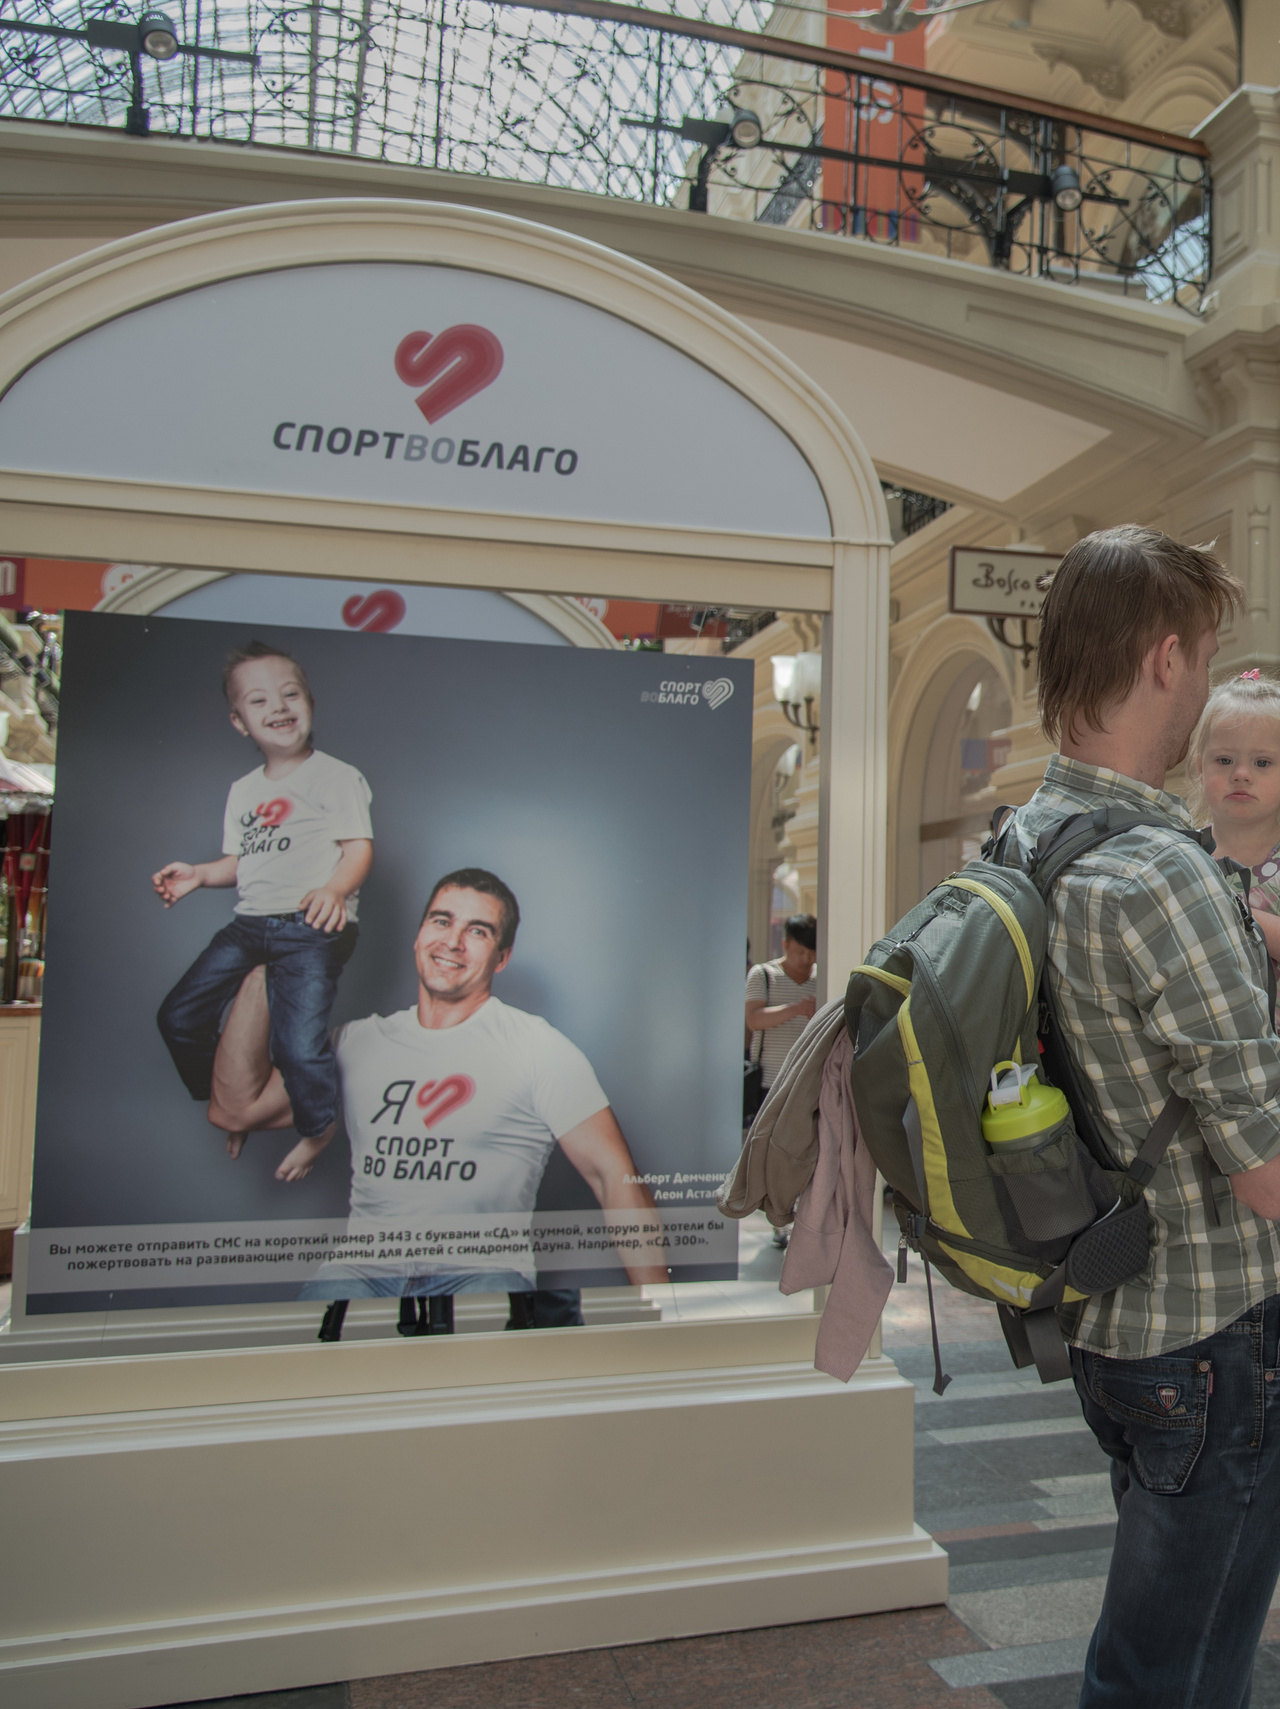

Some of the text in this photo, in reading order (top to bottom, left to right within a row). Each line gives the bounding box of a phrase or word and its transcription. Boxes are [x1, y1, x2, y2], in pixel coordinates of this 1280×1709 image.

[971, 562, 1031, 596] Bosco
[660, 680, 702, 694] СПОРТ
[370, 1080, 417, 1125] Я
[375, 1135, 455, 1158] СПОРТ
[363, 1155, 477, 1181] ВО БЛАГО
[622, 1171, 728, 1186] Альберт Демченк
[654, 1189, 684, 1201] Леон
[50, 1220, 724, 1255] Вы можете отправить СМС на короткий номер 3443 с буквами «СД» и суммой, которую вы хотели бы
[67, 1257, 172, 1272] пожертвовать
[176, 1256, 192, 1266] на
[196, 1251, 294, 1269] развивающие
[298, 1248, 374, 1263] программы
[377, 1247, 403, 1259] для
[405, 1244, 444, 1258] детей
[447, 1246, 454, 1255] с
[457, 1242, 529, 1256] синдромом
[532, 1240, 574, 1254] Дауна.
[577, 1238, 643, 1252] Например,
[646, 1236, 671, 1248] «СД
